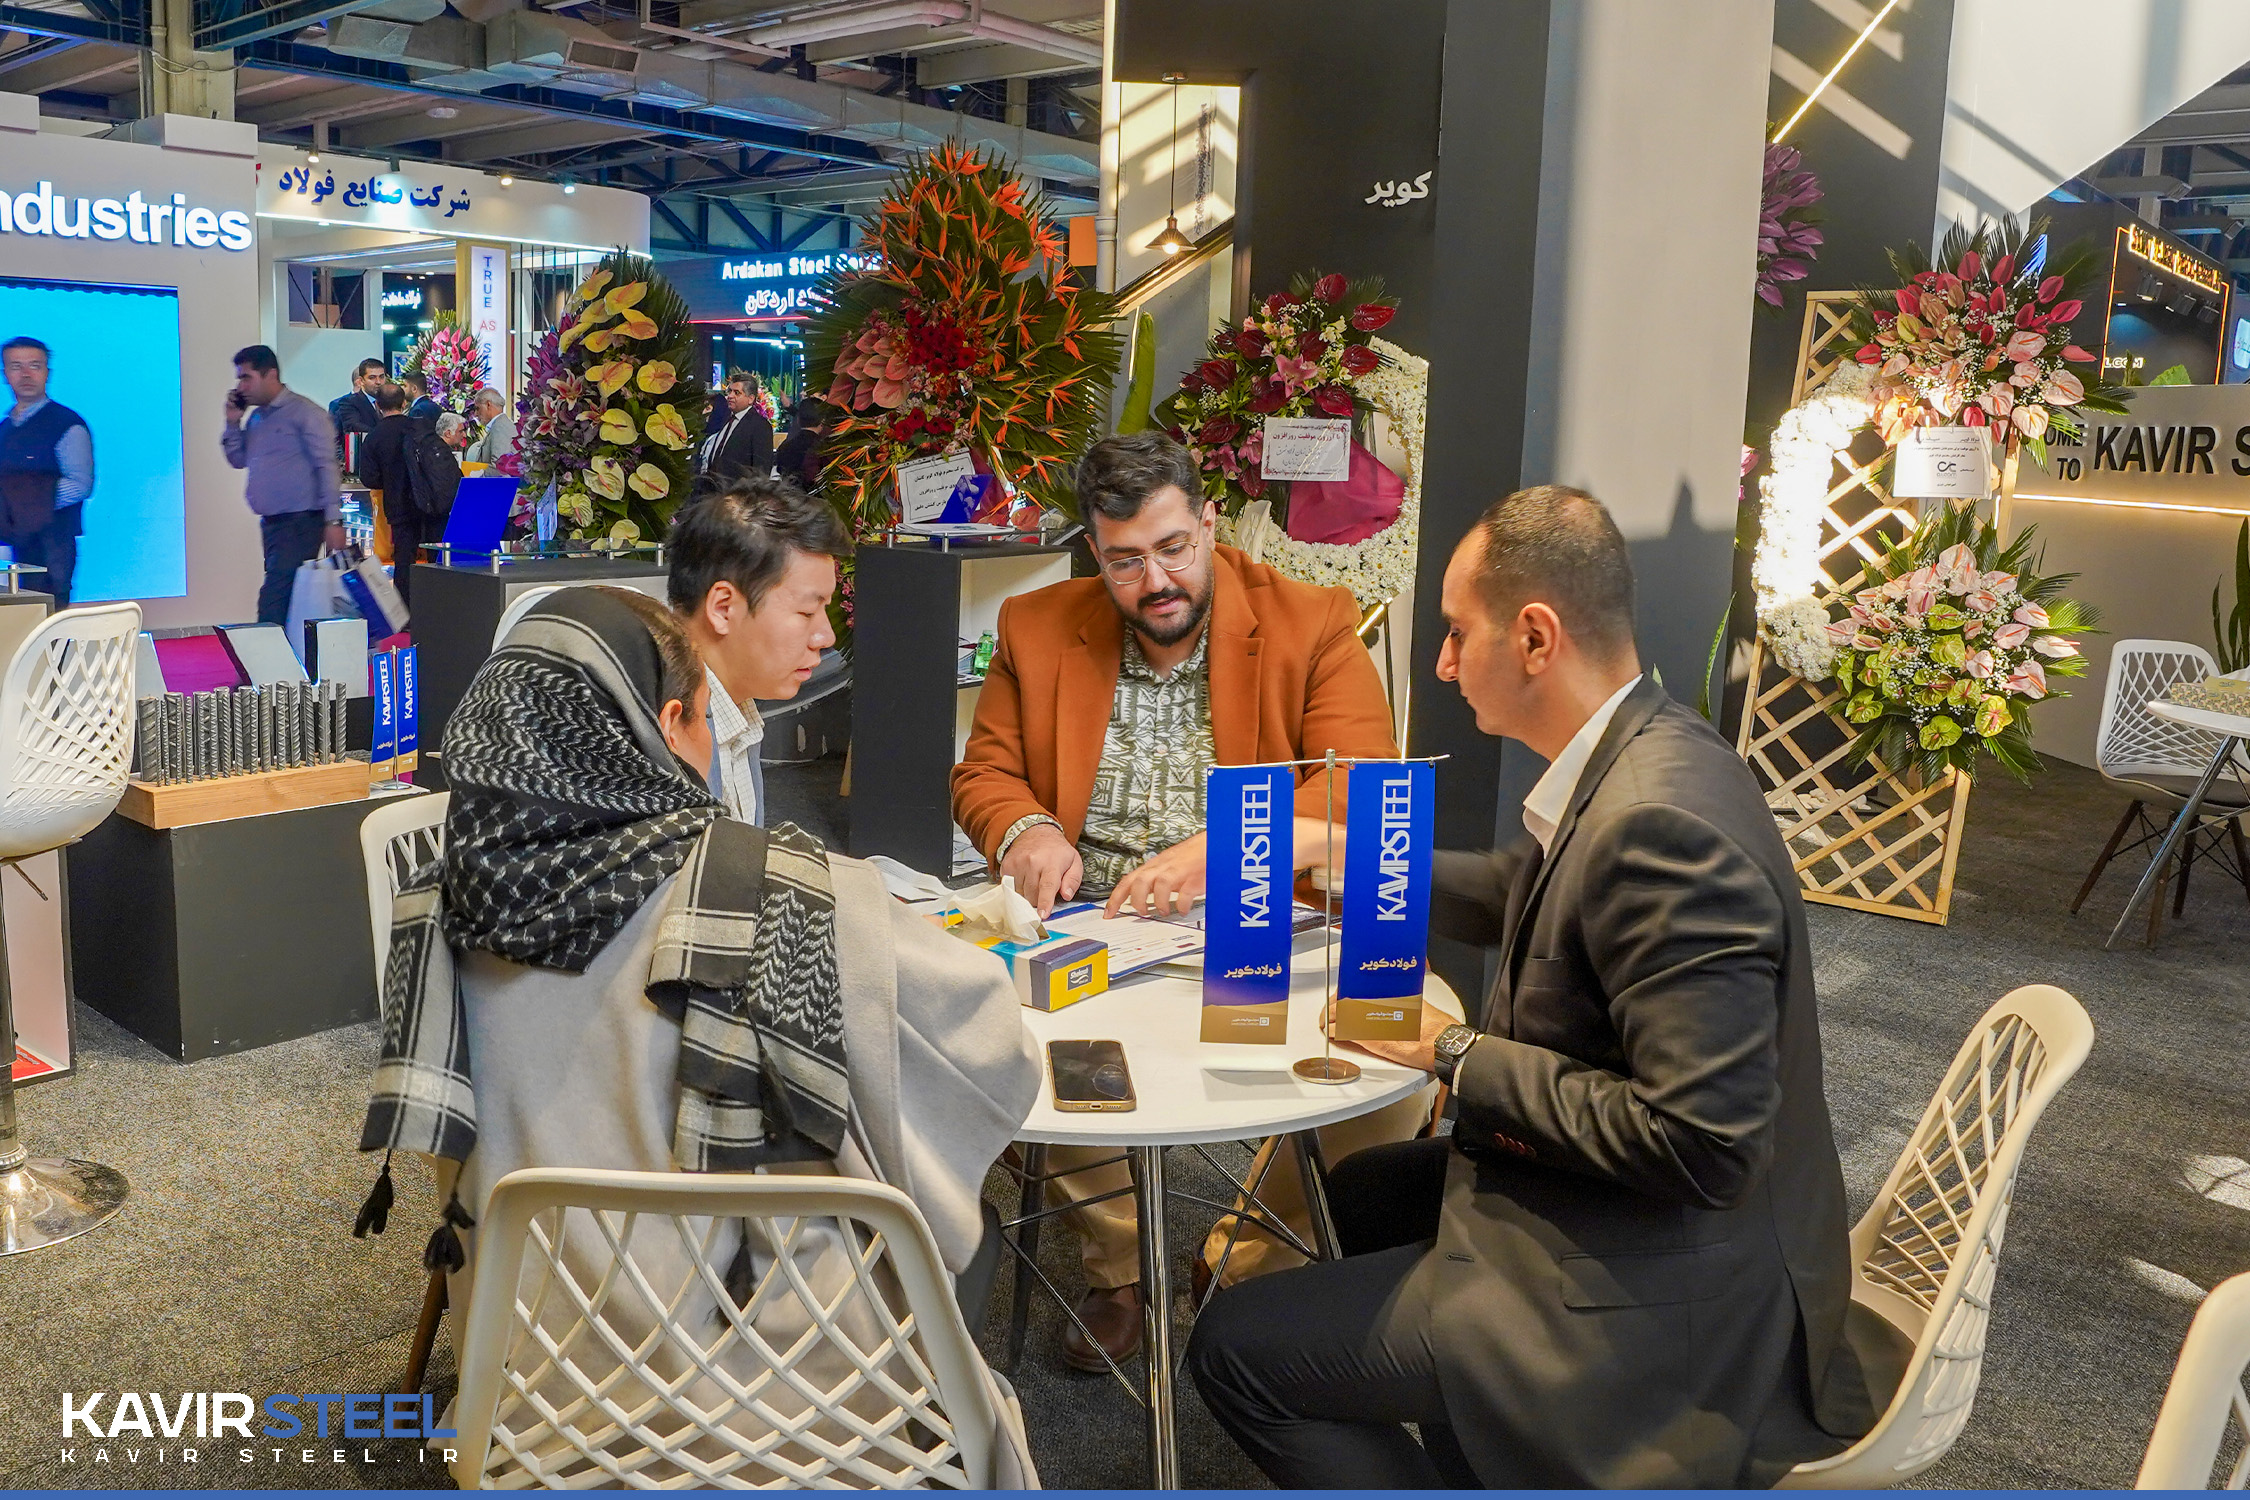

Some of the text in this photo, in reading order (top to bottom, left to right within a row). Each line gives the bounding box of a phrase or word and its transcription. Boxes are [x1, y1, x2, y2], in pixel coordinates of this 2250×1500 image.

[278, 166, 336, 206] فولاد
[342, 176, 404, 208] صنایع
[409, 184, 471, 218] شرکت
[1364, 170, 1433, 208] کویر
[483, 255, 493, 309] TRUE
[722, 260, 783, 280] Ardakan
[788, 254, 831, 275] Steel
[480, 320, 497, 331] AS
[2093, 425, 2217, 475] KAVIR
[2056, 457, 2081, 482] TO
[1239, 774, 1272, 928] KAVIRSTEEL
[1376, 769, 1412, 921] KAVIRSTEEL
